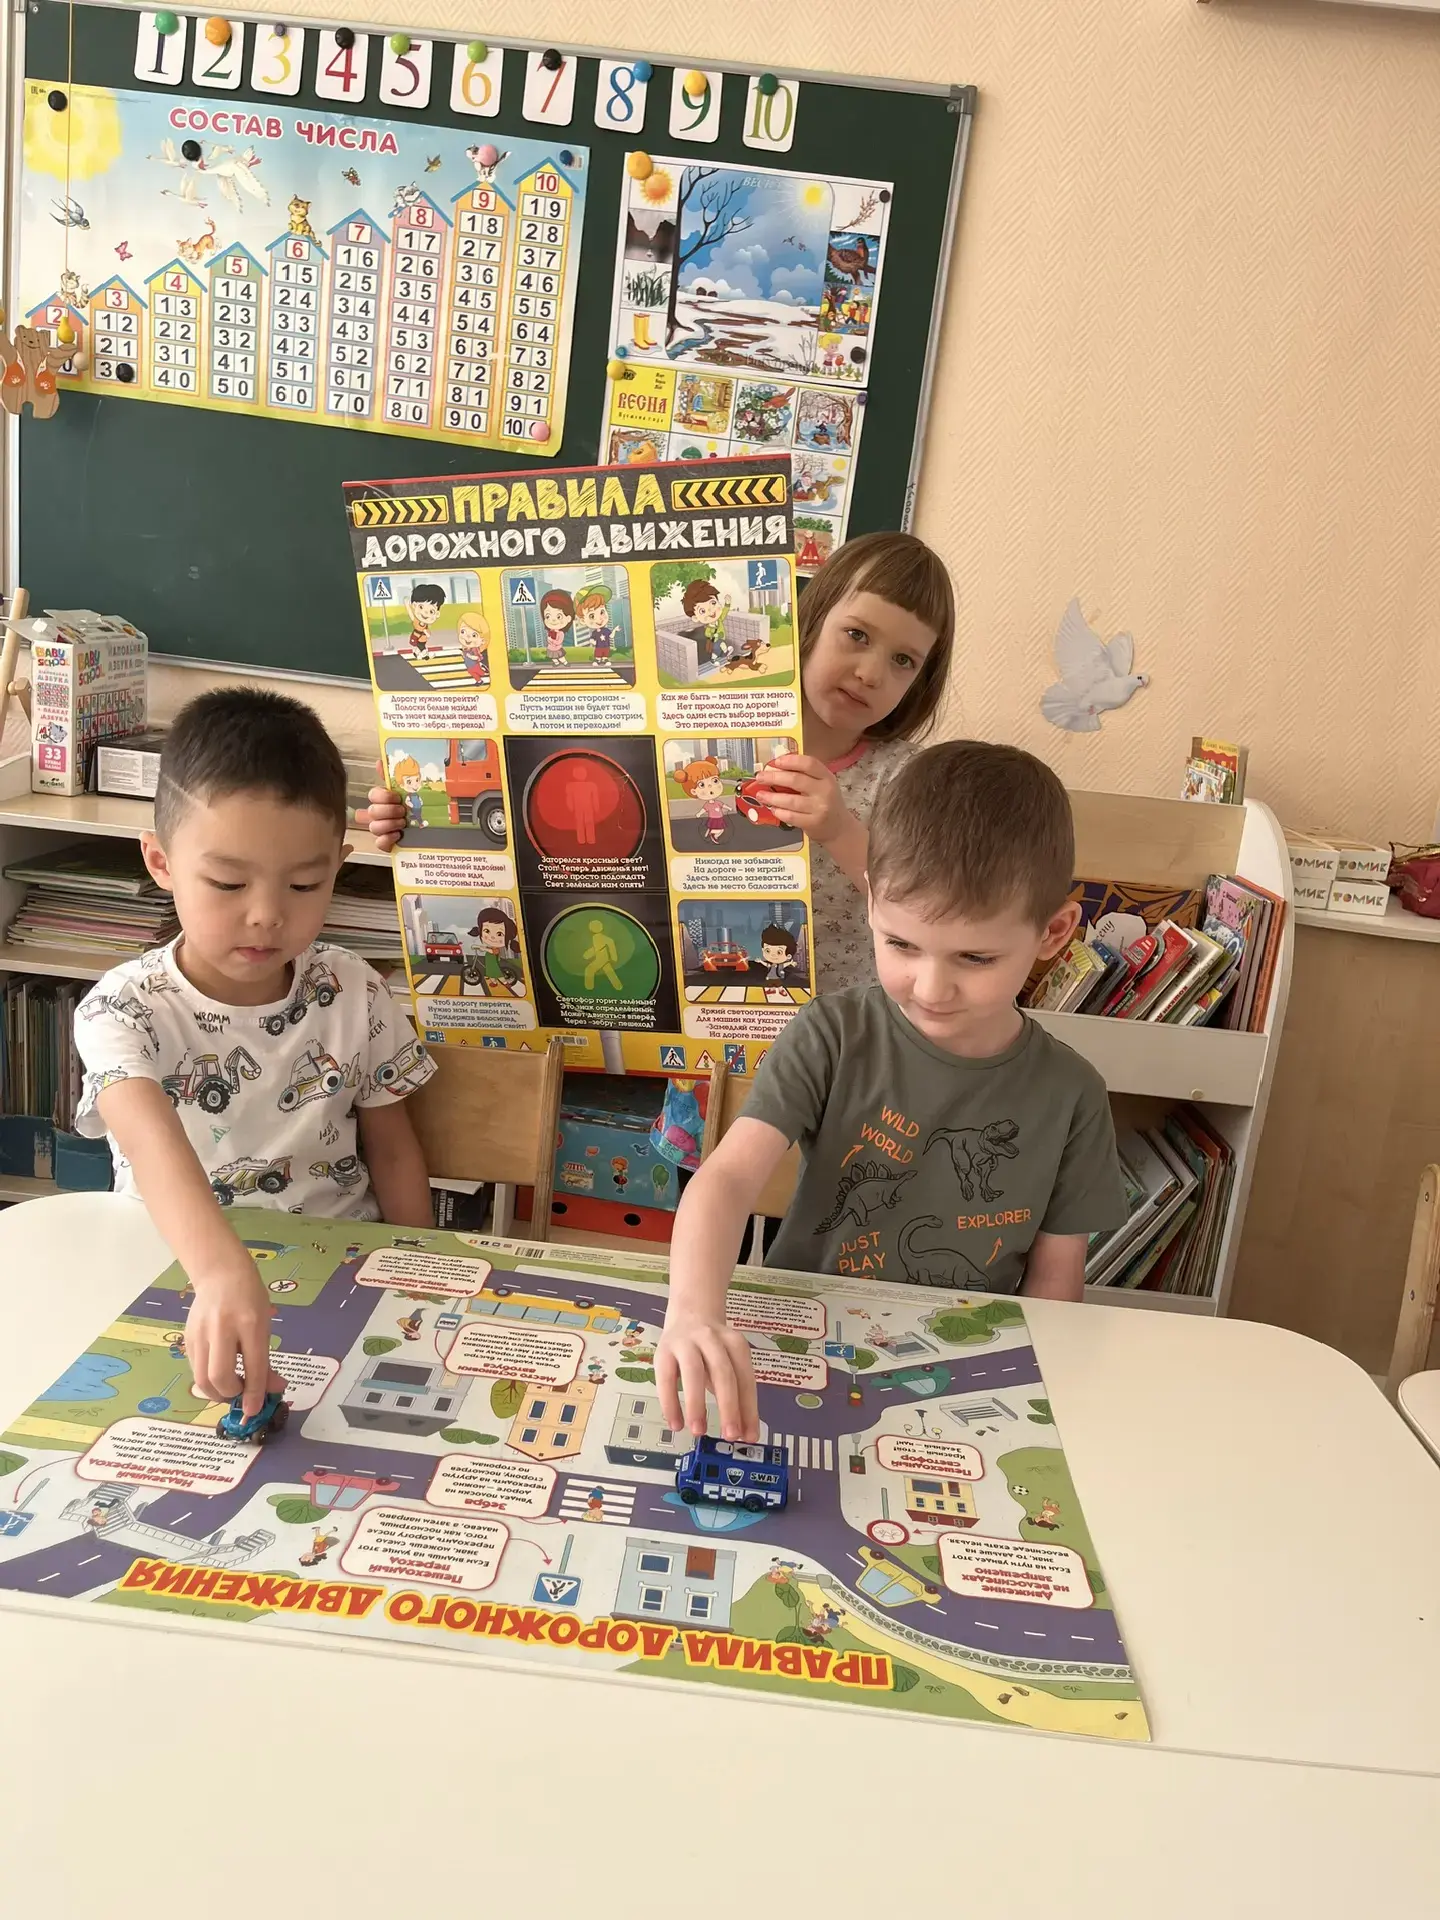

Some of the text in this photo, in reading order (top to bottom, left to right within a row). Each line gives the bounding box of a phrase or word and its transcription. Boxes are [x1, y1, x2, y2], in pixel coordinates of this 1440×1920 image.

[148, 24, 169, 75] 1
[202, 32, 232, 79] 2
[262, 33, 291, 84] 3
[325, 46, 358, 92] 4
[391, 45, 421, 96] 5
[462, 51, 492, 106] 6
[537, 61, 566, 113] 7
[606, 66, 634, 122] 8
[680, 81, 711, 131] 9
[746, 85, 792, 141] 10
[170, 109, 398, 153] СОСТАВ ЧИСЛА
[537, 175, 556, 191] 10
[480, 192, 489, 207] 9
[416, 209, 426, 224] 8
[354, 226, 364, 240] 7
[292, 242, 303, 257] 6
[232, 259, 242, 273] 5
[171, 276, 181, 289] 4
[112, 291, 122, 306] 3
[618, 392, 668, 414] ВЕСНА
[452, 474, 666, 524] ПРАВИЛА
[362, 516, 787, 568] ДОРОЖНОГО ДВИЖЕНИЯ
[36, 646, 65, 658] BABY
[38, 658, 70, 667] SCHOOL
[77, 650, 100, 670] BABY
[78, 664, 105, 686] SCHOOL
[522, 694, 563, 703] Посмотри
[745, 700, 778, 709] дороге!
[520, 703, 543, 712] Пусть
[586, 703, 609, 711] будет
[728, 710, 754, 719] выбор
[756, 709, 789, 718] верный
[508, 712, 546, 721] Смотрим
[730, 719, 782, 728] подземный!
[573, 721, 620, 730] переходим!
[44, 748, 61, 760] 33
[541, 855, 580, 864] Загорелся
[1339, 860, 1388, 872] ТОМИК
[757, 865, 784, 873] играй!
[1294, 887, 1326, 899] МИК
[1333, 892, 1384, 906] ТОМИК
[194, 1012, 230, 1024] WROMM
[880, 1105, 920, 1137] WILD
[861, 1123, 914, 1164] WORLD
[957, 1208, 1031, 1229] EXPLORER
[838, 1231, 880, 1256] JUST
[839, 1252, 886, 1273] PLAY
[457, 1365, 556, 1382] Место остановки
[481, 1363, 536, 1373] автобуса
[924, 1444, 961, 1452] Зелёный
[926, 1450, 965, 1459] Красный
[891, 1460, 971, 1476] Пешеходный
[898, 1454, 960, 1467] светофор
[89, 1458, 234, 1482] пешеходный переход
[751, 1472, 779, 1483] SWAT
[116, 1470, 193, 1487] Надземный
[492, 1479, 546, 1489] переходить
[458, 1490, 497, 1498] полоски
[500, 1495, 532, 1504] Увидел
[464, 1498, 507, 1510] Зебра
[377, 1512, 420, 1522] направо.
[461, 1523, 498, 1532] налево,
[427, 1553, 464, 1562] видишь
[1012, 1546, 1068, 1556] велосипеде
[389, 1556, 450, 1570] переход
[466, 1558, 489, 1566] Если
[368, 1564, 462, 1583] Пешеходный
[972, 1567, 1052, 1582] запрещено
[961, 1574, 1050, 1590] велосипедах
[981, 1584, 1052, 1600] Движение
[125, 1564, 887, 1684] ПРАВИЛА ДОРОЖНОГО ДВИЖЕНИЯ
